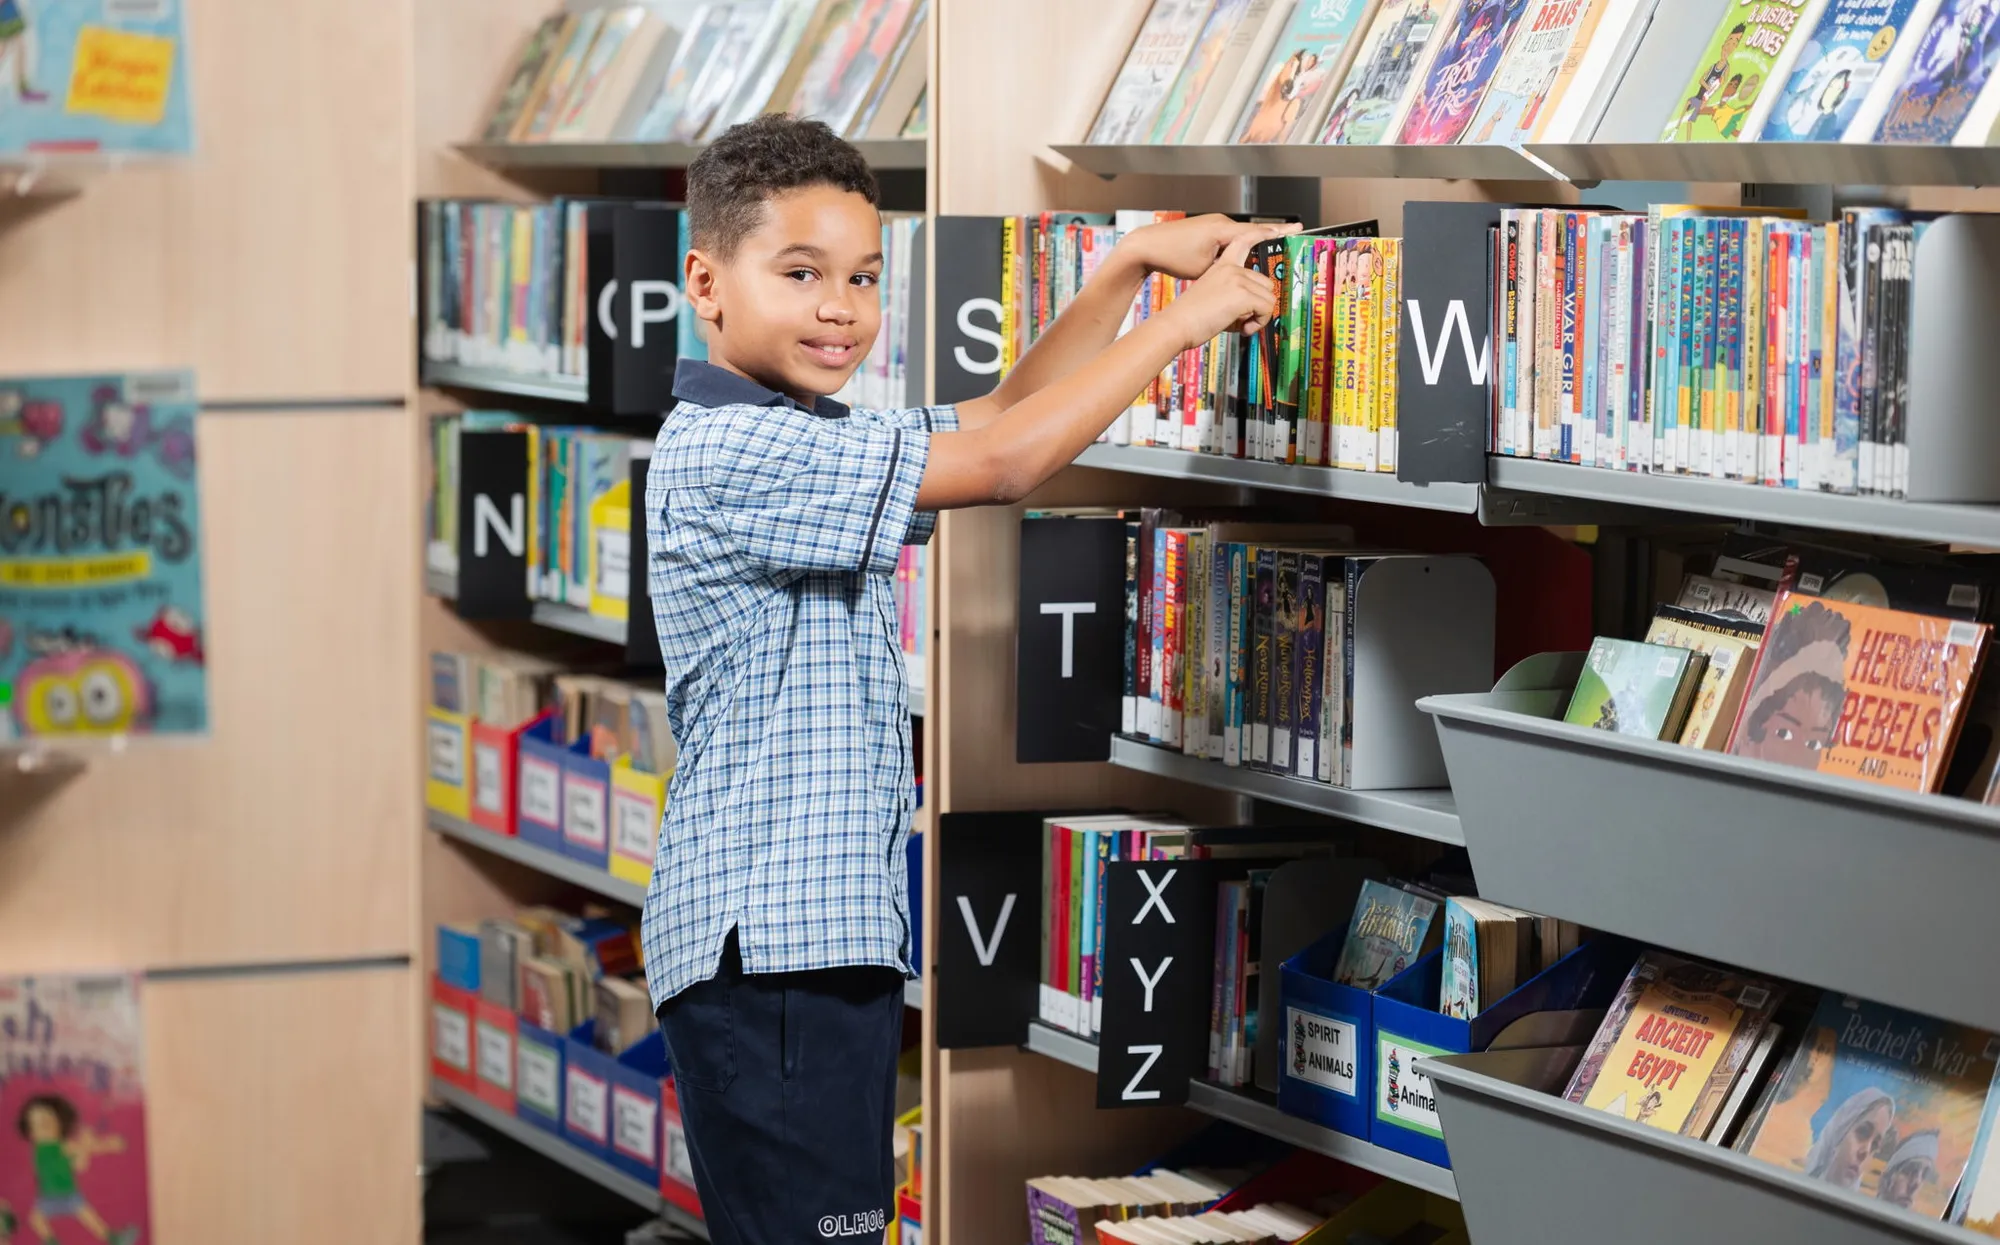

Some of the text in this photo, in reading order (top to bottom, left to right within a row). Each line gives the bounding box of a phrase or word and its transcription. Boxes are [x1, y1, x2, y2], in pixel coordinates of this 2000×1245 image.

[1531, 0, 1582, 32] DRAWS
[1745, 24, 1785, 58] JONES
[1756, 5, 1799, 33] JUSTICE
[1508, 242, 1516, 282] COWBOY
[1648, 212, 1659, 321] HORIZON
[1682, 230, 1694, 276] TURTLE
[1705, 231, 1715, 278] TURTLE
[1729, 231, 1740, 278] TURTLE
[631, 280, 680, 348] P
[1576, 286, 1585, 299] KID
[1693, 234, 1705, 359] WOMBAT WARRIORS
[954, 298, 1003, 375] S
[1311, 296, 1326, 388] funny kid
[1357, 299, 1369, 394] funny kid
[1407, 299, 1488, 386] W
[1562, 292, 1576, 392] WAR GIR
[473, 493, 525, 558] N
[1166, 534, 1177, 550] AS
[1165, 551, 1177, 580] FAST
[1165, 580, 1176, 598] AS
[1153, 571, 1164, 640] CLARA
[1163, 604, 1174, 629] CAN
[1212, 559, 1225, 655] WILD STORIES
[1231, 575, 1241, 675] GOLDFISH BOY
[1040, 602, 1096, 678] T
[1850, 627, 1958, 703] HEROES
[1300, 645, 1316, 723] Hollowpox
[1834, 691, 1942, 762] REBELS
[1858, 756, 1888, 779] AND
[1131, 868, 1178, 925] X
[956, 893, 1017, 967] V
[1129, 956, 1174, 1012] Y
[1308, 1021, 1341, 1045] SPIRIT
[1635, 1013, 1715, 1059] ANCIENT
[1840, 1013, 1976, 1078] Rachel's War
[1121, 1044, 1163, 1100] Z
[1308, 1052, 1353, 1079] ANIMALS
[1626, 1049, 1687, 1091] EGYPT
[1401, 1085, 1437, 1113] Anima
